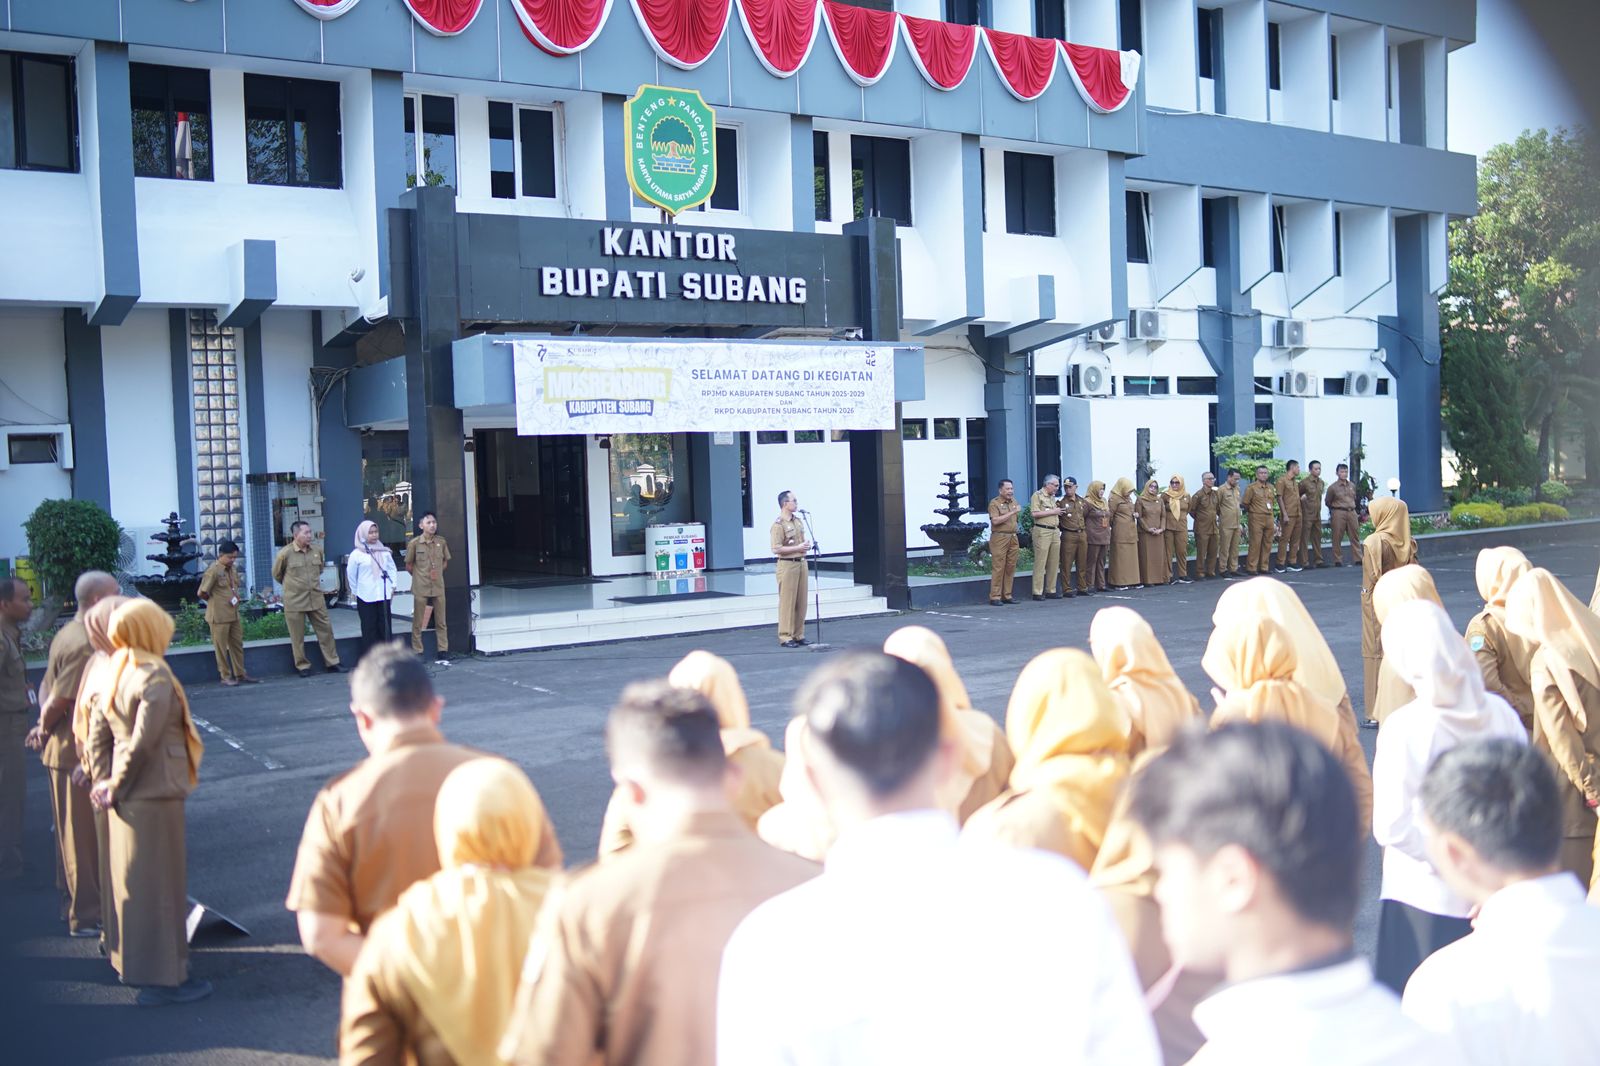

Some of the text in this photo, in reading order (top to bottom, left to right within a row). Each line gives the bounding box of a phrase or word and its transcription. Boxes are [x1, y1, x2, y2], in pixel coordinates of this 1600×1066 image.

[636, 98, 665, 149] BENTENG
[679, 100, 709, 155] PANCASILA
[637, 158, 709, 202] KARYA UTAMA SATYA NAGARA
[603, 227, 737, 261] KANTOR
[541, 266, 807, 304] BUPATI SUBANG
[691, 369, 873, 382] SELAMAT DATANG DI KEGIATAN
[569, 400, 651, 414] KABUPATEN SUBANG
[831, 390, 865, 398] 2025-2029
